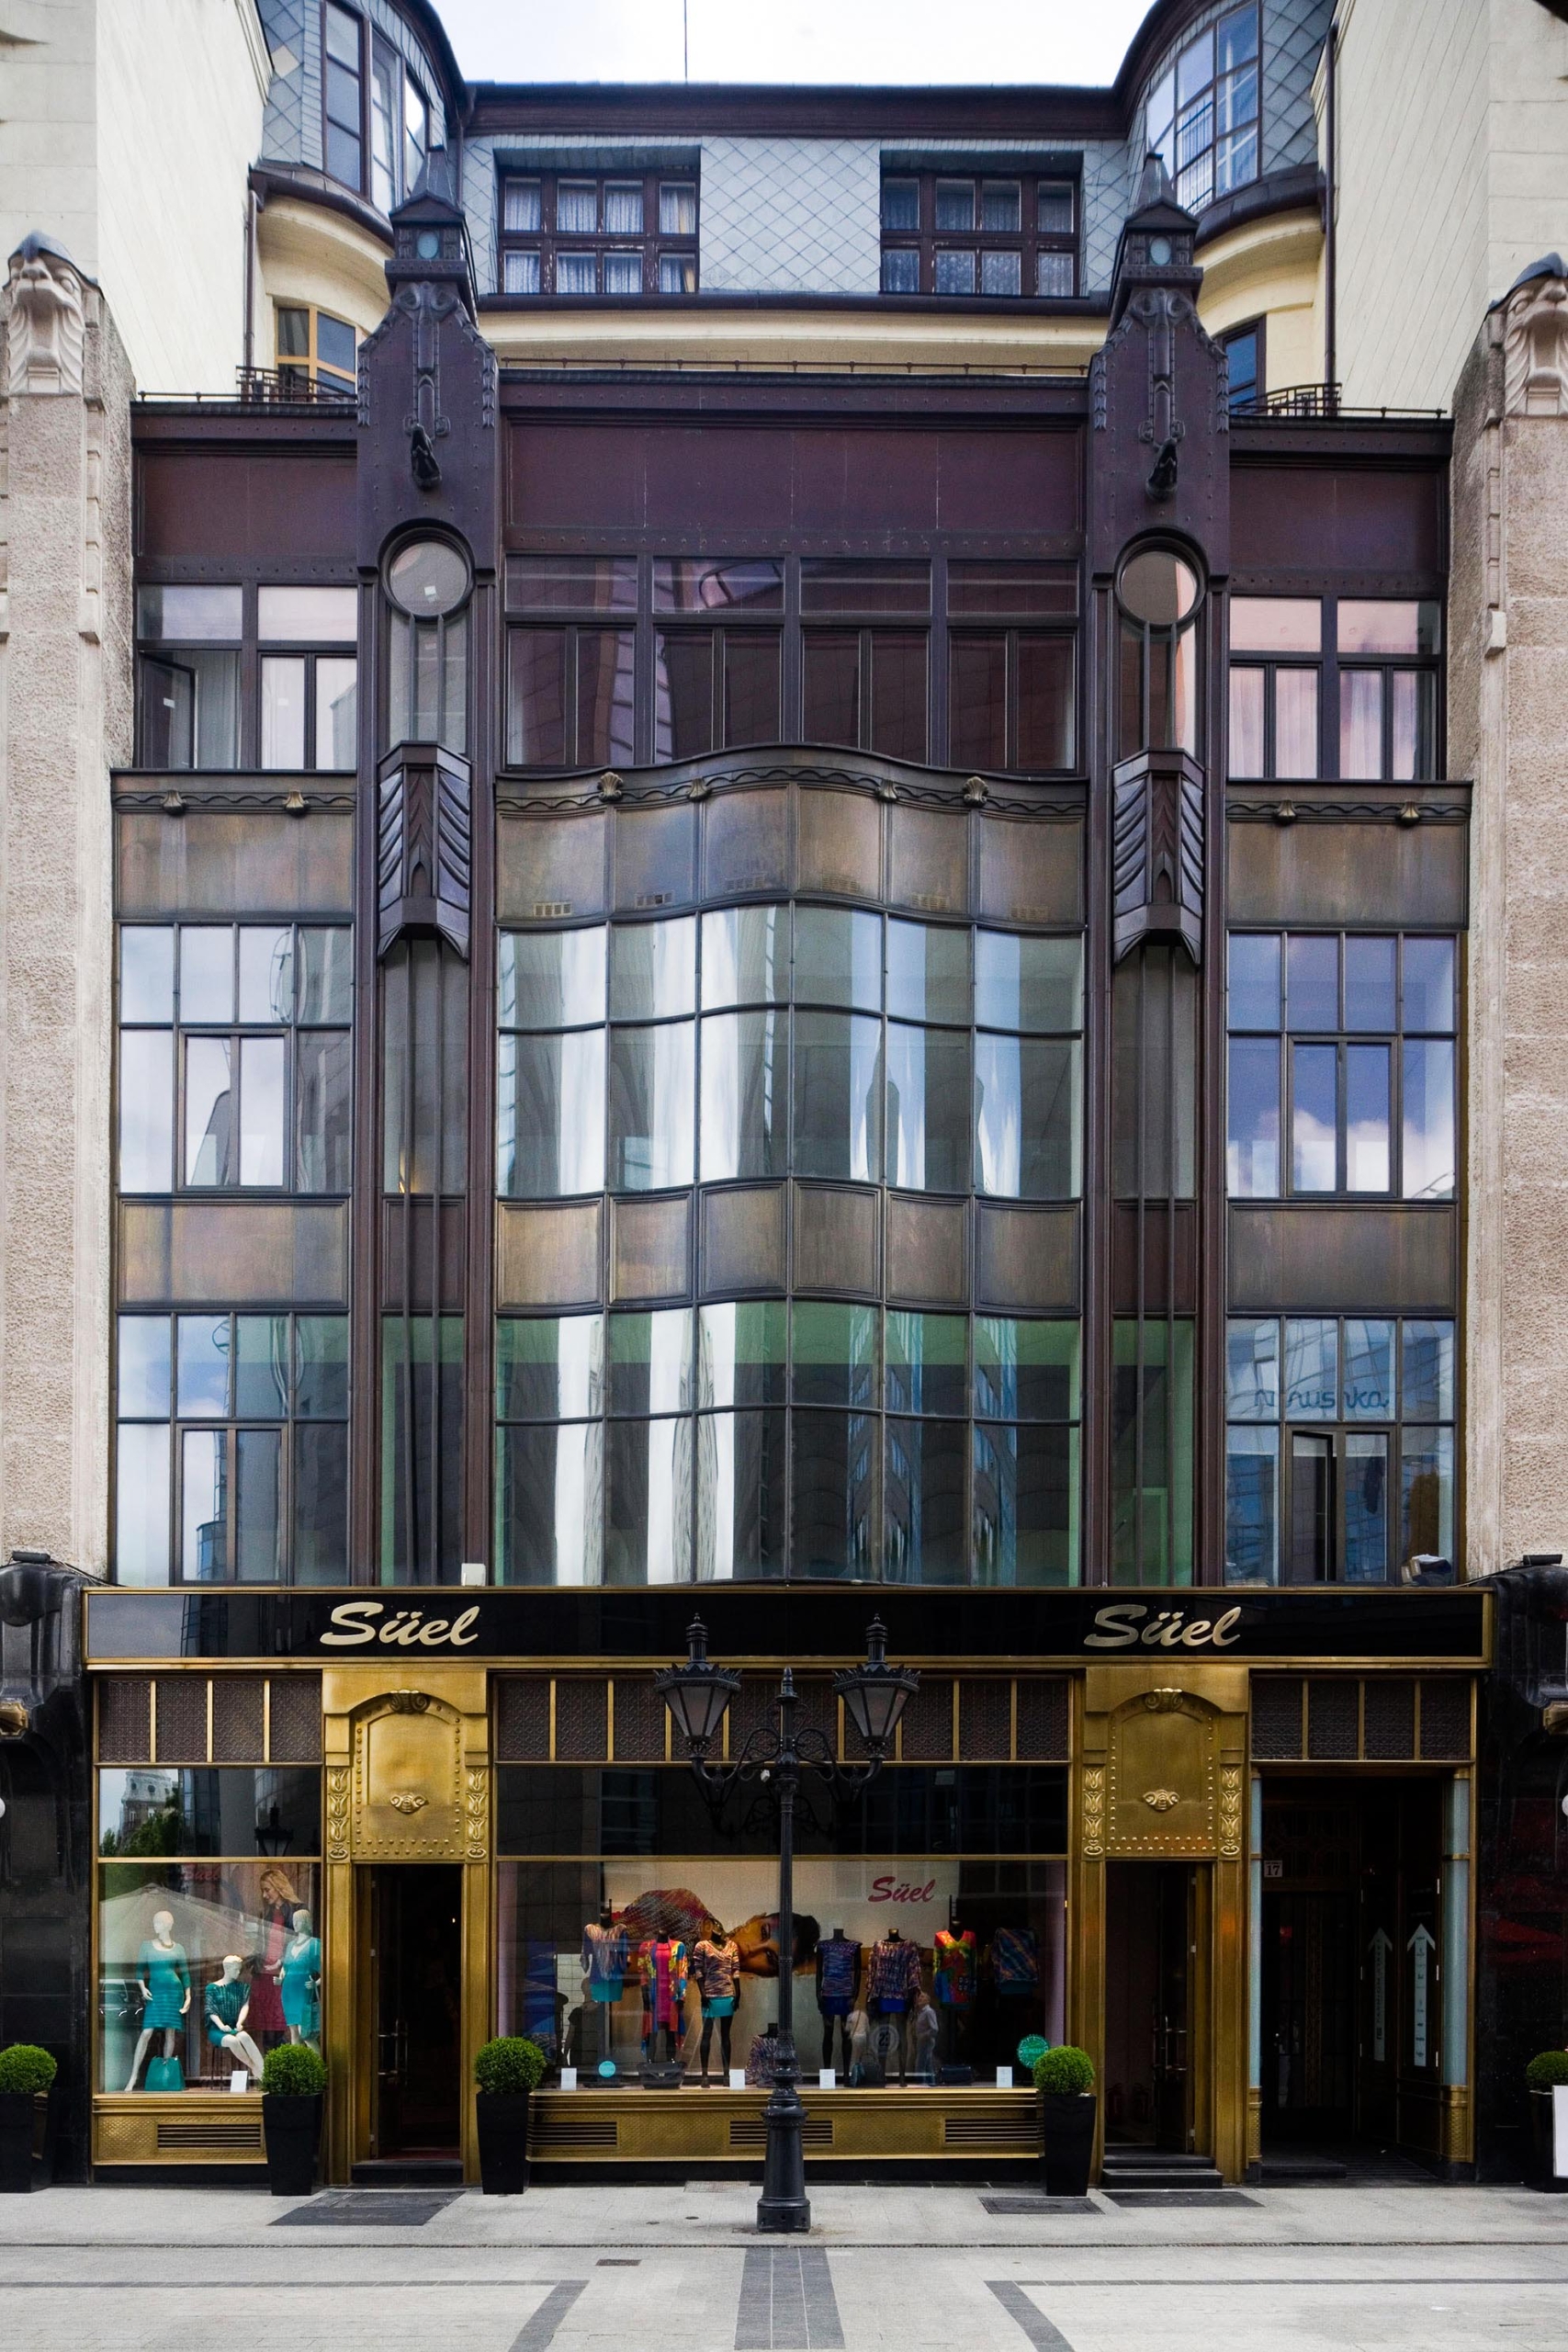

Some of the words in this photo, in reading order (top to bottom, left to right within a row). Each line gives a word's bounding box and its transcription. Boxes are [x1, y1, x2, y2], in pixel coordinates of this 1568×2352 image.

[1254, 1386, 1390, 1409] nnuska
[320, 1601, 480, 1645] Süel
[1083, 1604, 1242, 1647] Süel
[1266, 1865, 1280, 1876] 17
[868, 1876, 935, 1903] Süel
